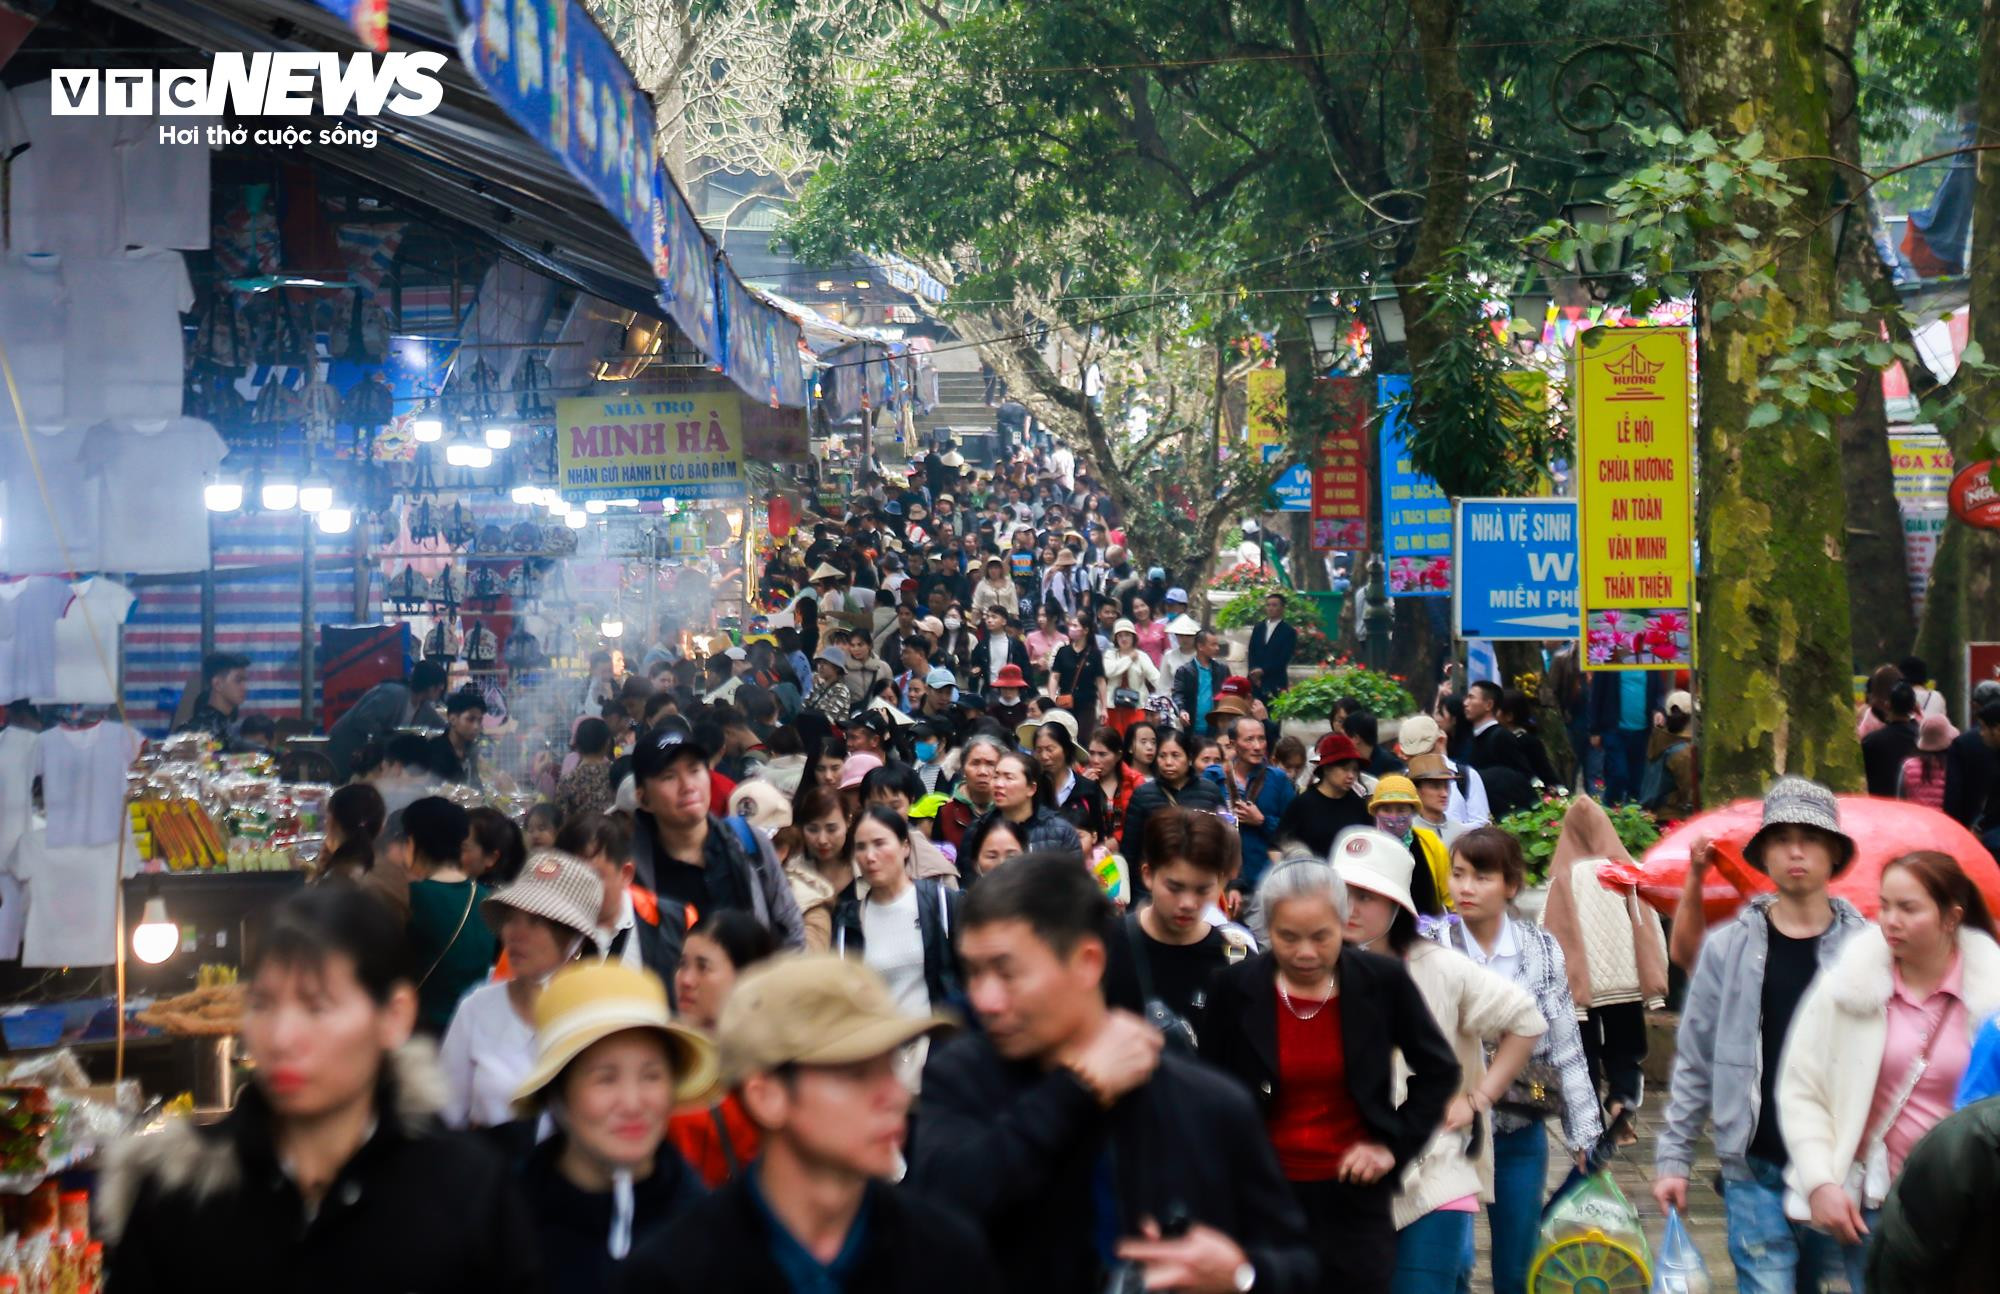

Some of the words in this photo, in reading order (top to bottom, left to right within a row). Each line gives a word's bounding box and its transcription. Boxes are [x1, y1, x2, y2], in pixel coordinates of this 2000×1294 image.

[604, 401, 646, 416] NHÀ
[652, 400, 695, 418] TRỌ
[570, 423, 667, 458] MINH
[676, 410, 731, 453] HÀ
[1634, 415, 1654, 448] HỘI
[567, 465, 598, 488] NHẬN
[601, 460, 619, 483] GỬI
[622, 461, 651, 482] HÀNH
[655, 460, 667, 480] LÝ
[670, 460, 684, 480] CÓ
[687, 455, 709, 479] BẢO
[712, 454, 737, 478] ĐẢM
[1599, 455, 1630, 482] CHÙA
[1634, 456, 1674, 481] HƯƠNG
[1611, 498, 1629, 521] AN
[1632, 494, 1662, 521] TOÀN
[1471, 507, 1505, 542] NHÀ
[1509, 507, 1528, 549] VỆ
[1532, 512, 1571, 542] SINH
[1608, 533, 1632, 560] VĂN
[1636, 537, 1667, 560] MINH
[1528, 552, 1578, 581] W
[1489, 583, 1540, 608] MIỄN
[1604, 571, 1635, 599] THÂN
[1639, 571, 1672, 604] THIỆN
